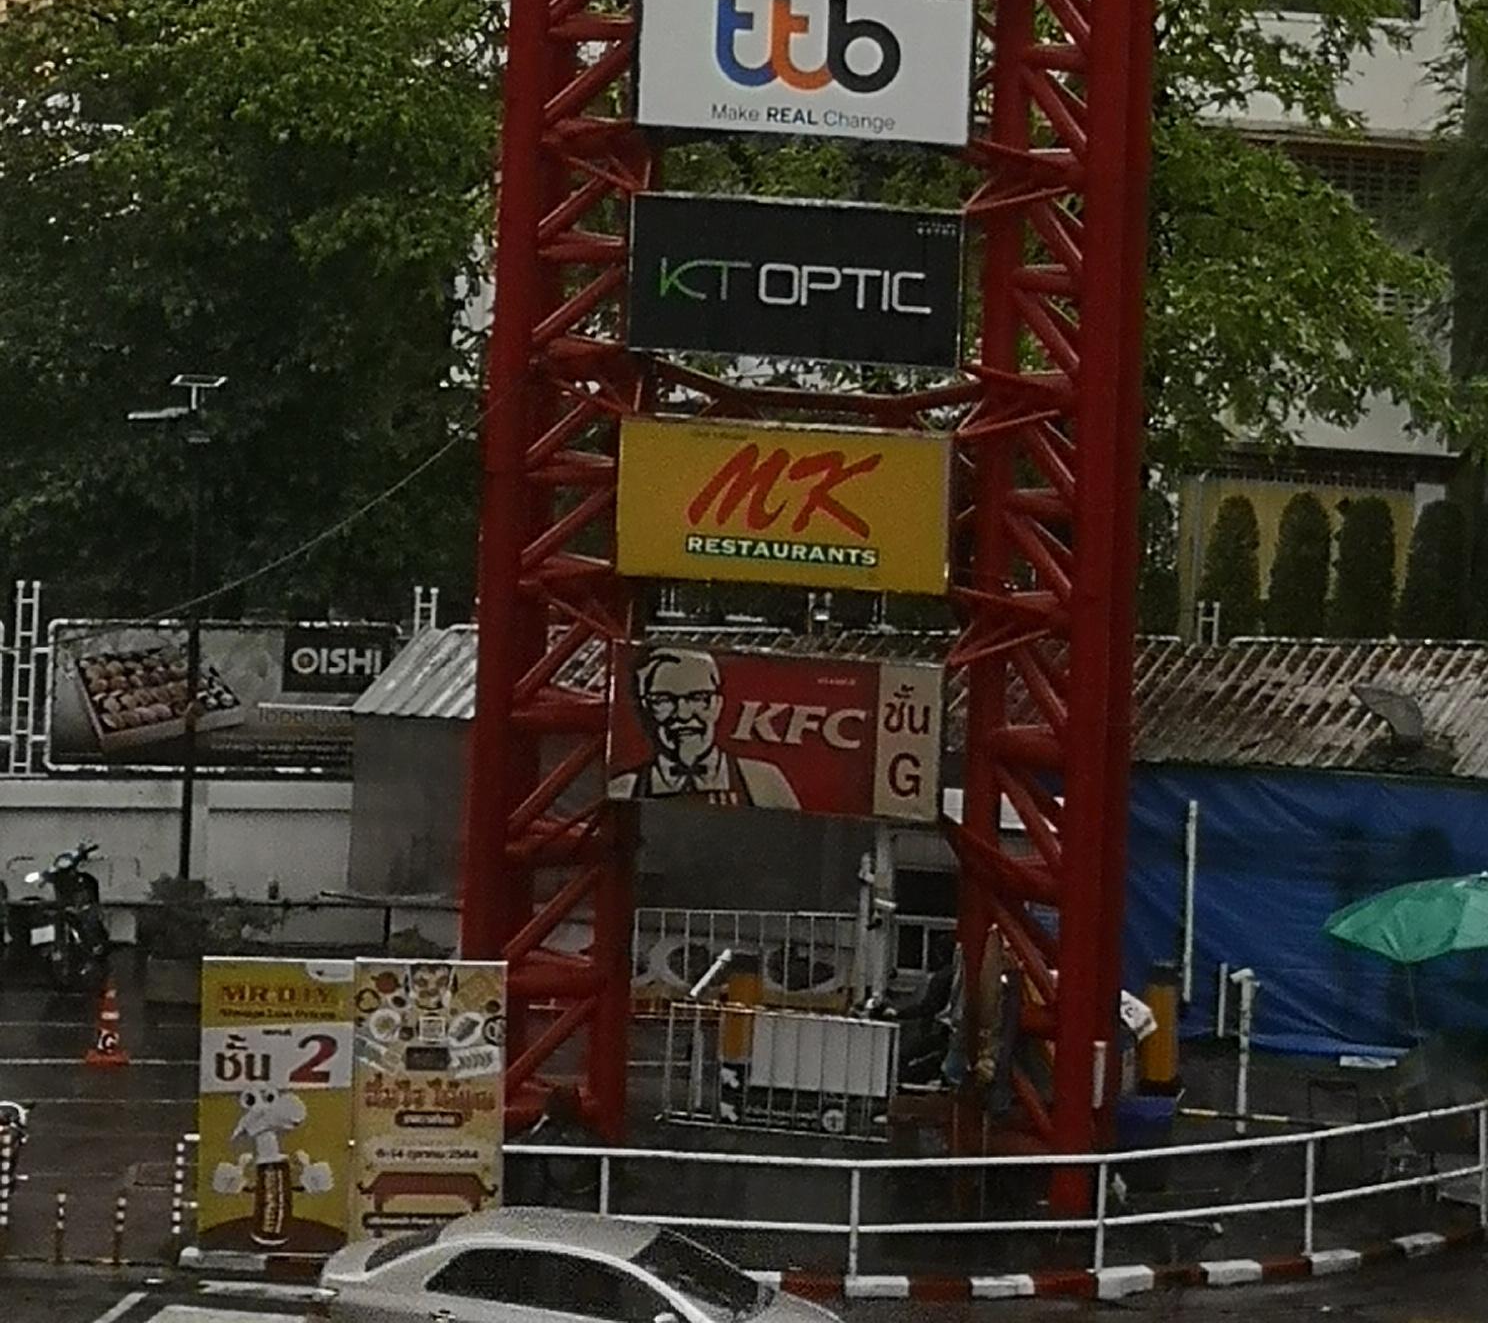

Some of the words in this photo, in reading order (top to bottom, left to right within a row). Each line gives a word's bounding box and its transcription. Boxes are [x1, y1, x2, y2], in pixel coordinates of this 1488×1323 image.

[711, 103, 760, 121] Make
[767, 106, 818, 125] REAL
[824, 110, 896, 134] Change
[660, 257, 752, 300] KT
[759, 263, 932, 315] OPTIC
[687, 443, 882, 539] MK
[687, 536, 877, 566] RESTAURANTS
[291, 647, 383, 676] OISHI
[731, 700, 867, 749] KFC
[882, 685, 930, 737] ชั้น
[888, 753, 921, 798] G
[214, 1034, 271, 1081] ชั้น
[289, 1035, 338, 1083] 2
